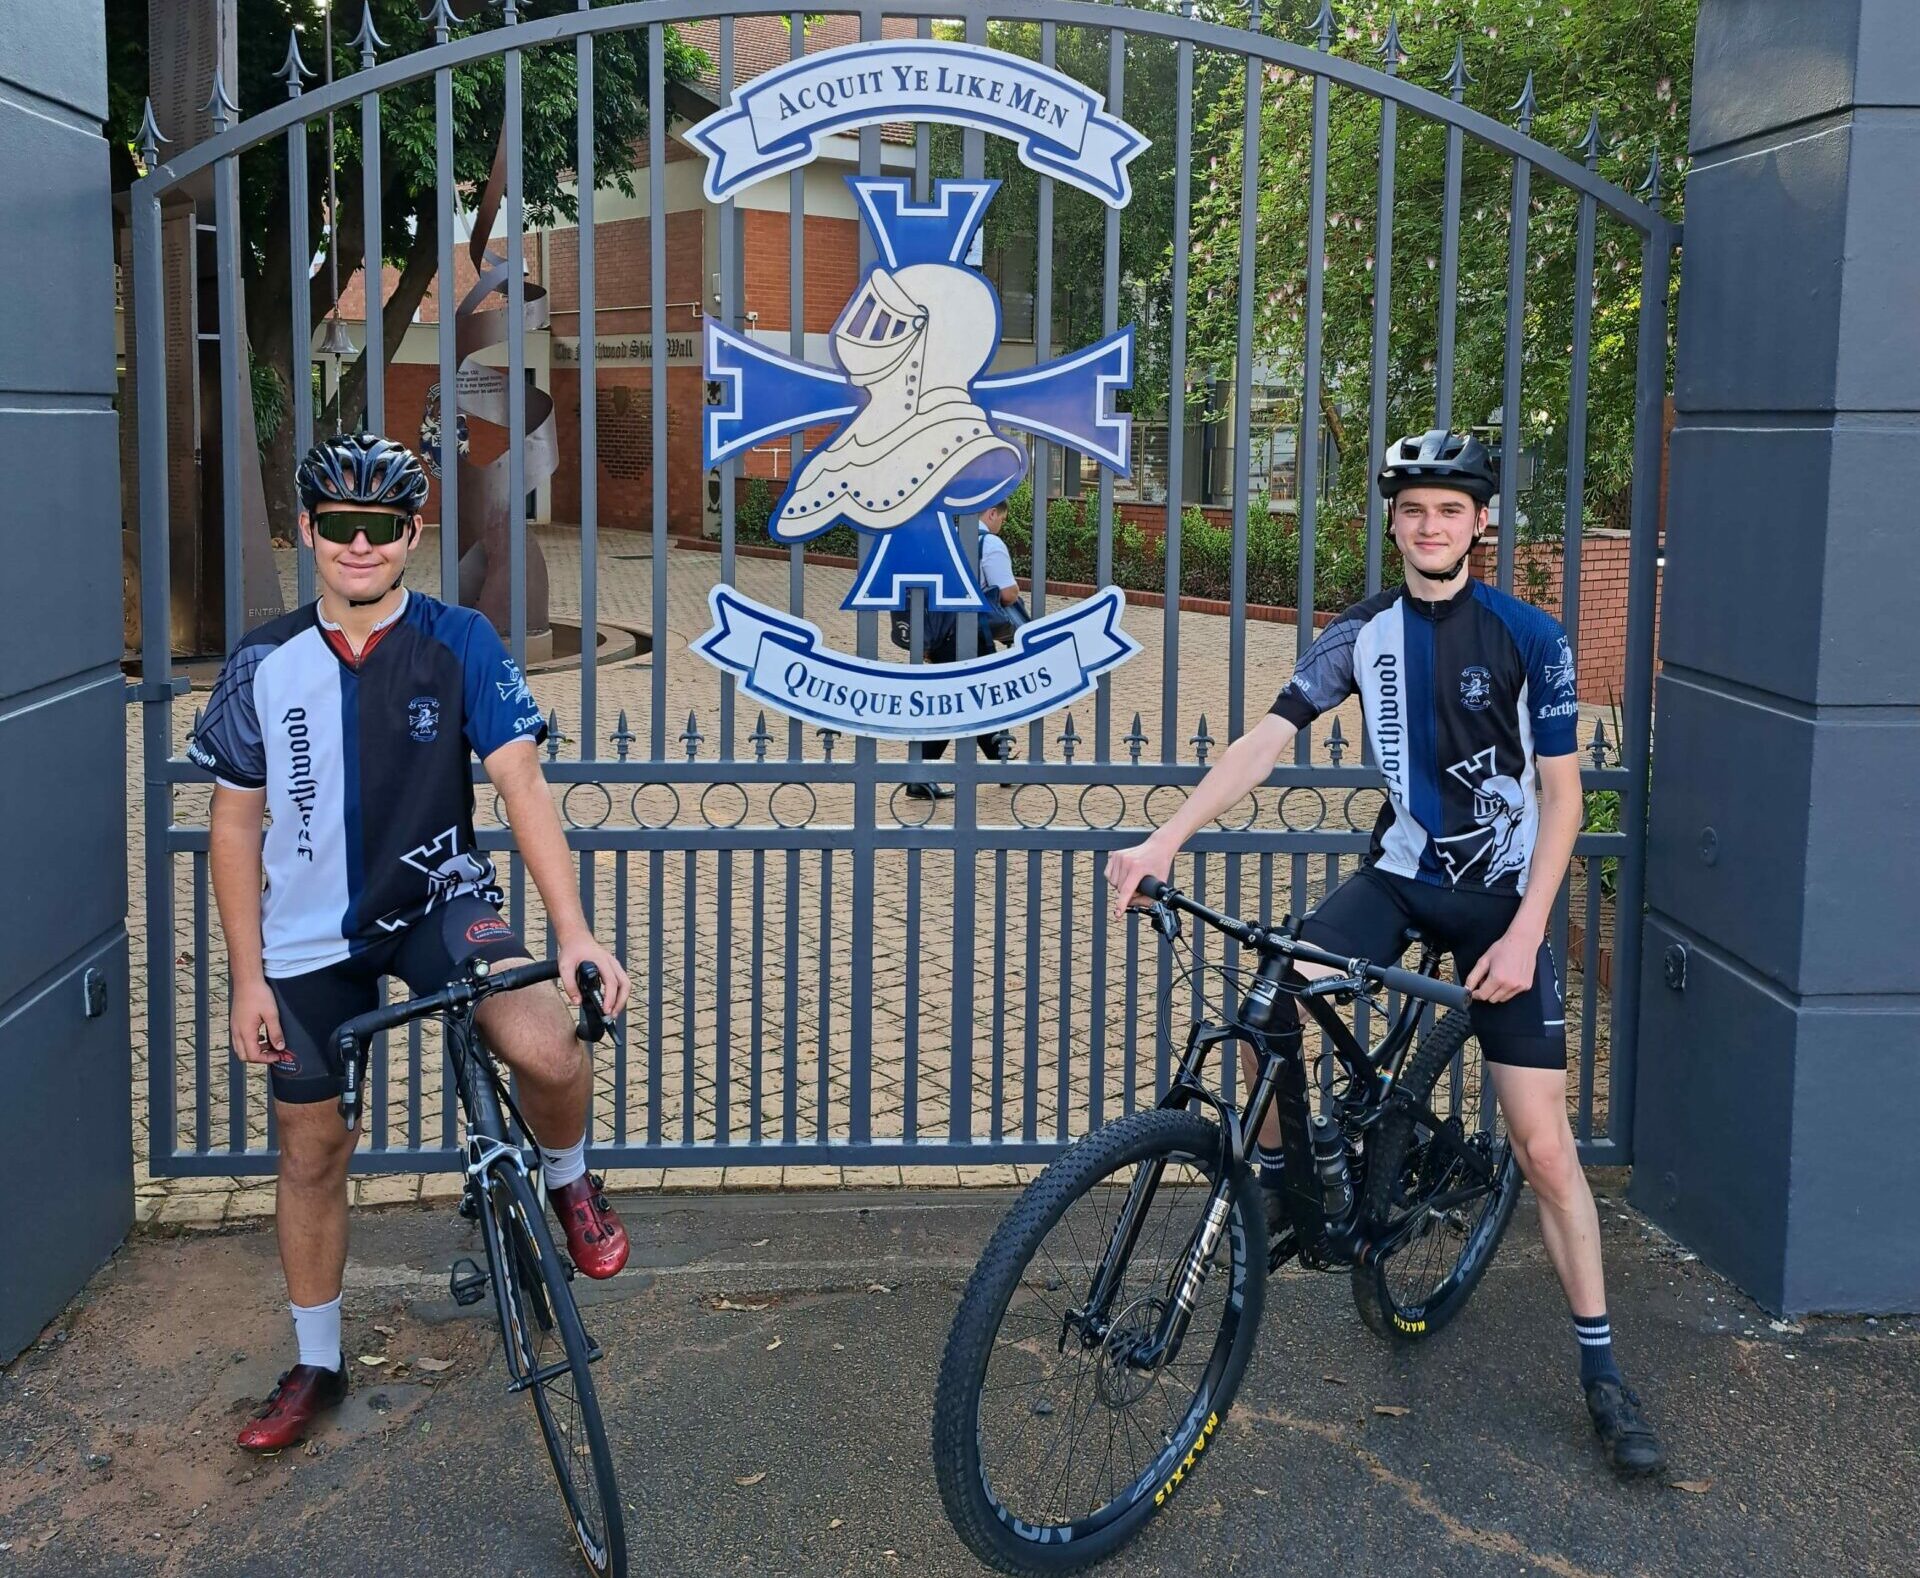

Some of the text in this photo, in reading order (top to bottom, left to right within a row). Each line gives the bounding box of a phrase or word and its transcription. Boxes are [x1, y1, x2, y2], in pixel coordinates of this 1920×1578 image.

[779, 65, 1070, 129] ACQUIT YE LIKE MEN
[784, 661, 1053, 718] QUISQUE SIBI VERUS
[1154, 1410, 1219, 1506] MAXXIS
